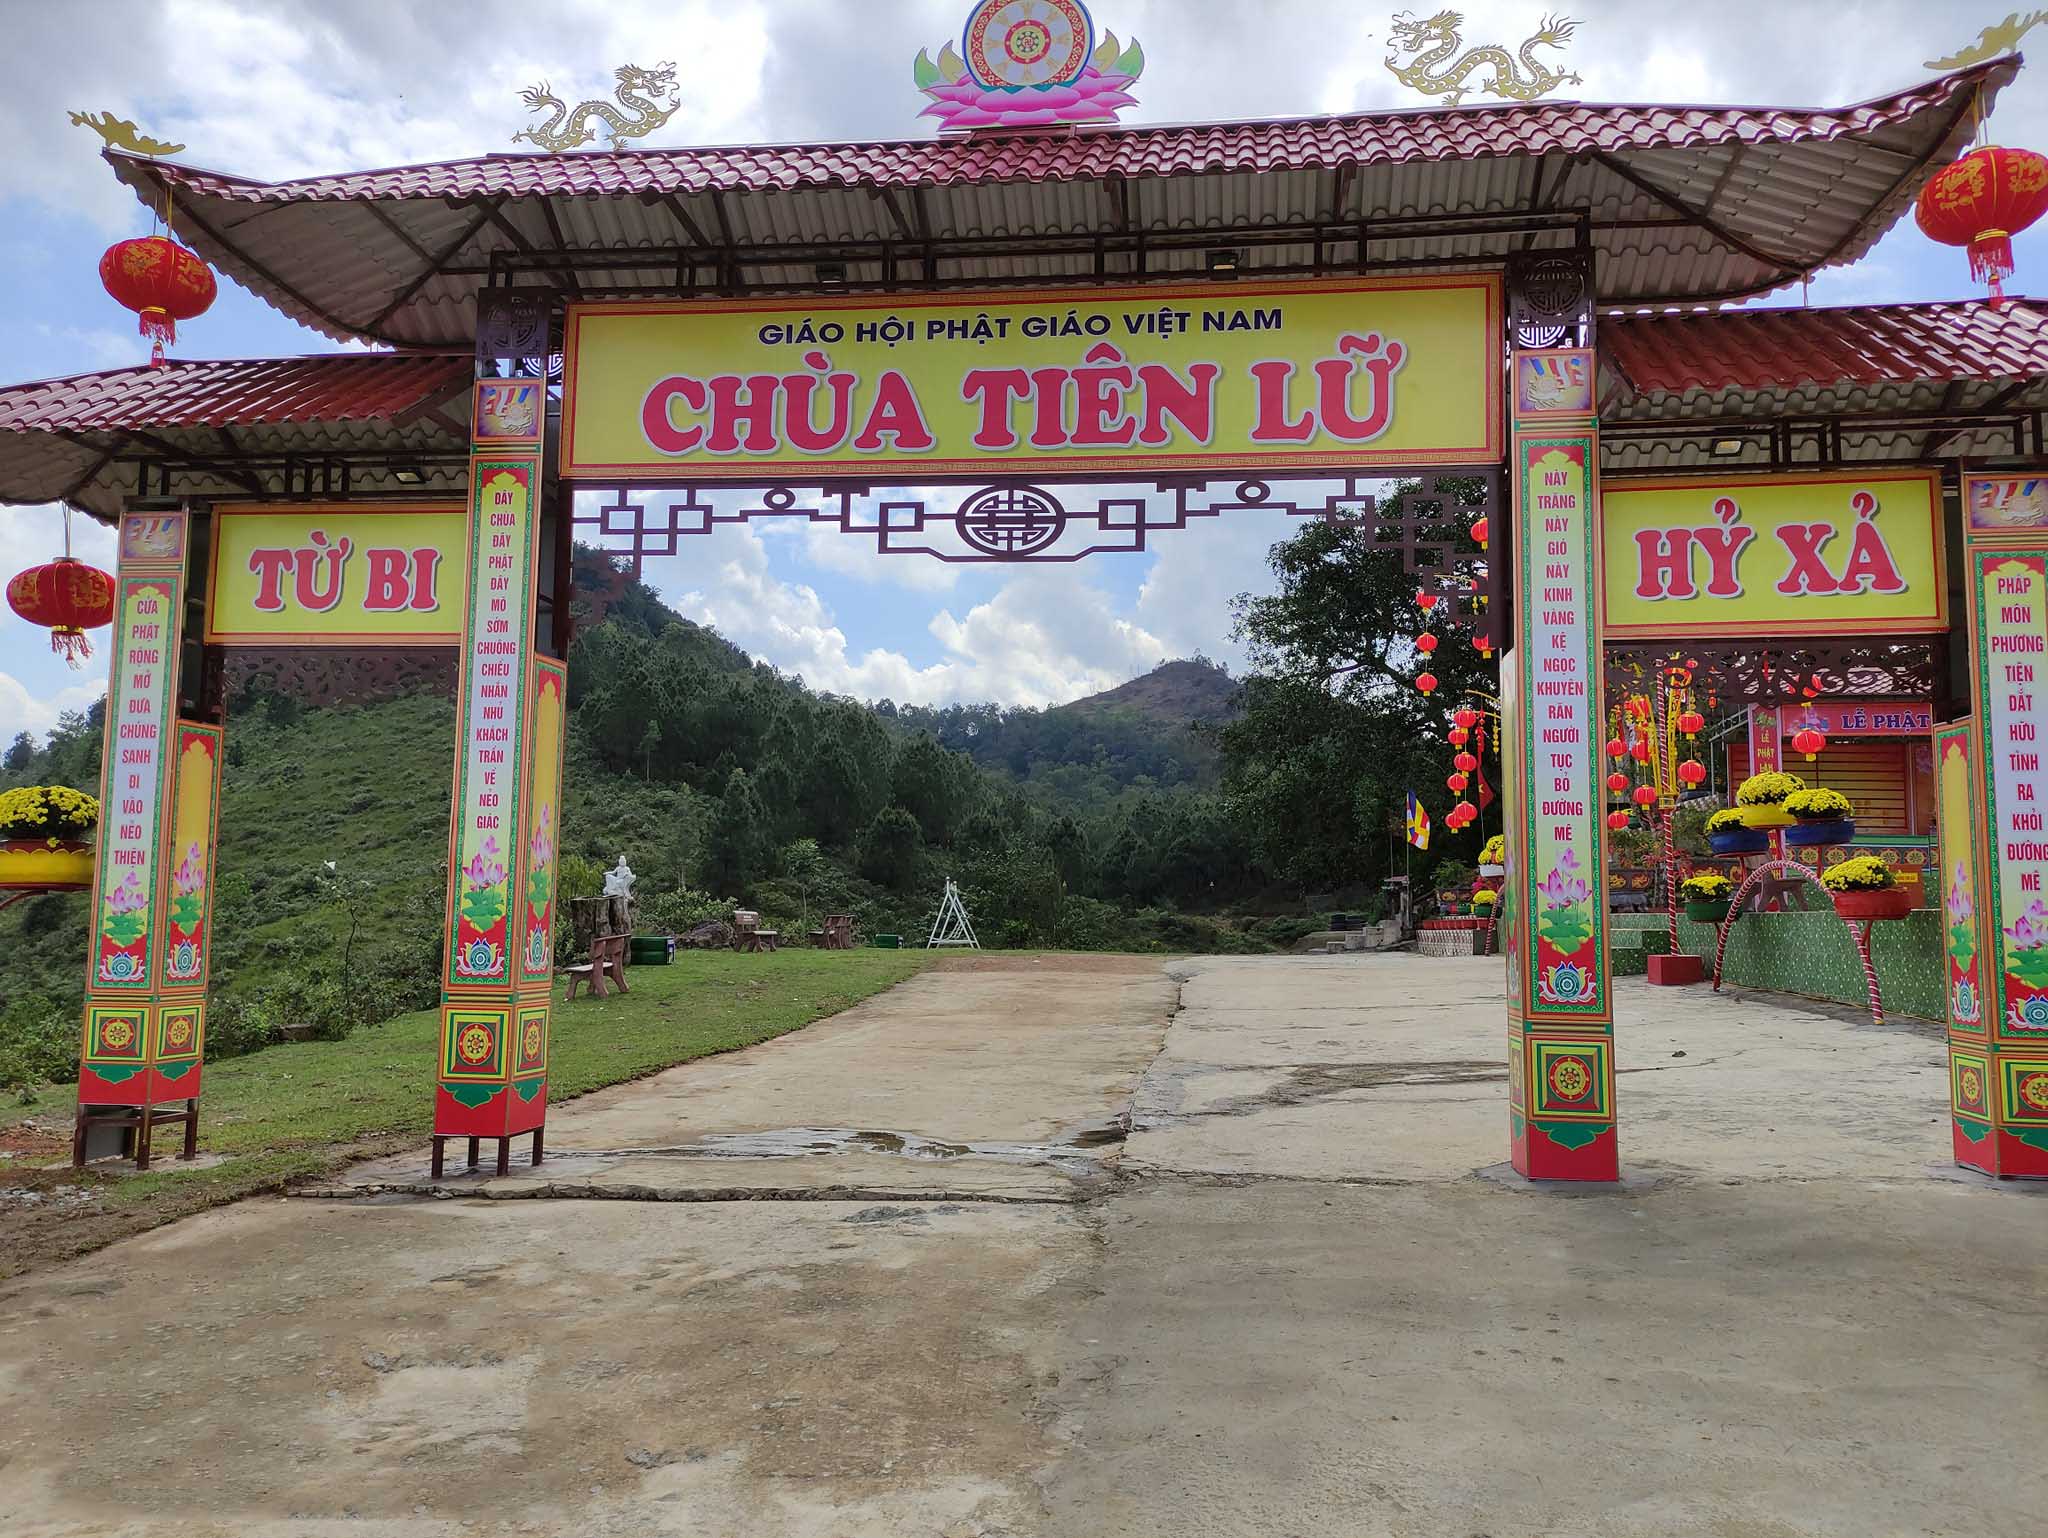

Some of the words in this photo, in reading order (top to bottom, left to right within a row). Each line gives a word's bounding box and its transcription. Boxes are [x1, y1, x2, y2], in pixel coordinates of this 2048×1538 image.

[758, 318, 845, 345] GIÁO
[856, 315, 915, 348] HỘI
[926, 313, 1011, 345] PHẬT
[1021, 310, 1111, 338] GIÁO
[1123, 307, 1191, 340] VIỆT
[1202, 308, 1282, 333] NAM
[641, 350, 934, 455] CHÙA
[961, 342, 1223, 450] TIÊN
[1248, 333, 1406, 445] LỮ
[1544, 469, 1568, 486] NÀY
[494, 490, 513, 505] ĐÂY
[1537, 491, 1576, 509] TRĂNG
[490, 509, 516, 526] CHÙA
[1545, 515, 1569, 532] NÀY
[492, 532, 511, 547] ĐÂY
[1547, 537, 1567, 555] GIÓ
[1633, 496, 1753, 600] HỶ
[1775, 490, 1907, 594] XẢ
[249, 530, 352, 611] TỪ
[363, 547, 440, 611] BI
[488, 554, 513, 572] PHẬT
[1546, 561, 1570, 578] NÀY
[490, 574, 509, 590] ĐÂY
[1997, 573, 2032, 594] PHÁP
[1544, 587, 1573, 602] KINH
[137, 594, 158, 615] CỬA
[2001, 603, 2031, 624] MÔN
[486, 616, 509, 633] SỚM
[1543, 608, 1575, 625] VÀNG
[132, 622, 160, 642] PHẬT
[477, 639, 516, 655] CHUÔNG
[1551, 631, 1567, 652] KỆ
[1991, 634, 2044, 653] PHƯƠNG
[129, 646, 159, 668] RỘNG
[1543, 658, 1576, 675] NGỌC
[2005, 662, 2034, 686] TIỆN
[1537, 678, 1584, 696] KHUYÊN
[129, 697, 151, 714] ĐƯA
[1841, 707, 1867, 730] LỄ
[1871, 710, 1930, 733] PHẬT
[120, 720, 157, 739] CHÚNG
[476, 725, 508, 742] KHÁCH
[1543, 725, 1579, 743] NGƯỜI
[2009, 721, 2035, 741] HỮU
[122, 748, 151, 764] SANH
[1550, 753, 1573, 771] TỤC
[2009, 750, 2039, 771] TÌNH
[129, 774, 140, 789] ĐI
[1554, 772, 1570, 792] BỎ
[2017, 783, 2035, 801] RA
[122, 796, 143, 815] VÀO
[1542, 797, 1583, 816] ĐƯỜNG
[476, 812, 500, 829] GIÁC
[2012, 808, 2043, 831] KHỎI
[1554, 824, 1573, 841] MÊ
[114, 847, 145, 868] THIỆN
[2021, 870, 2041, 891] MÊ
